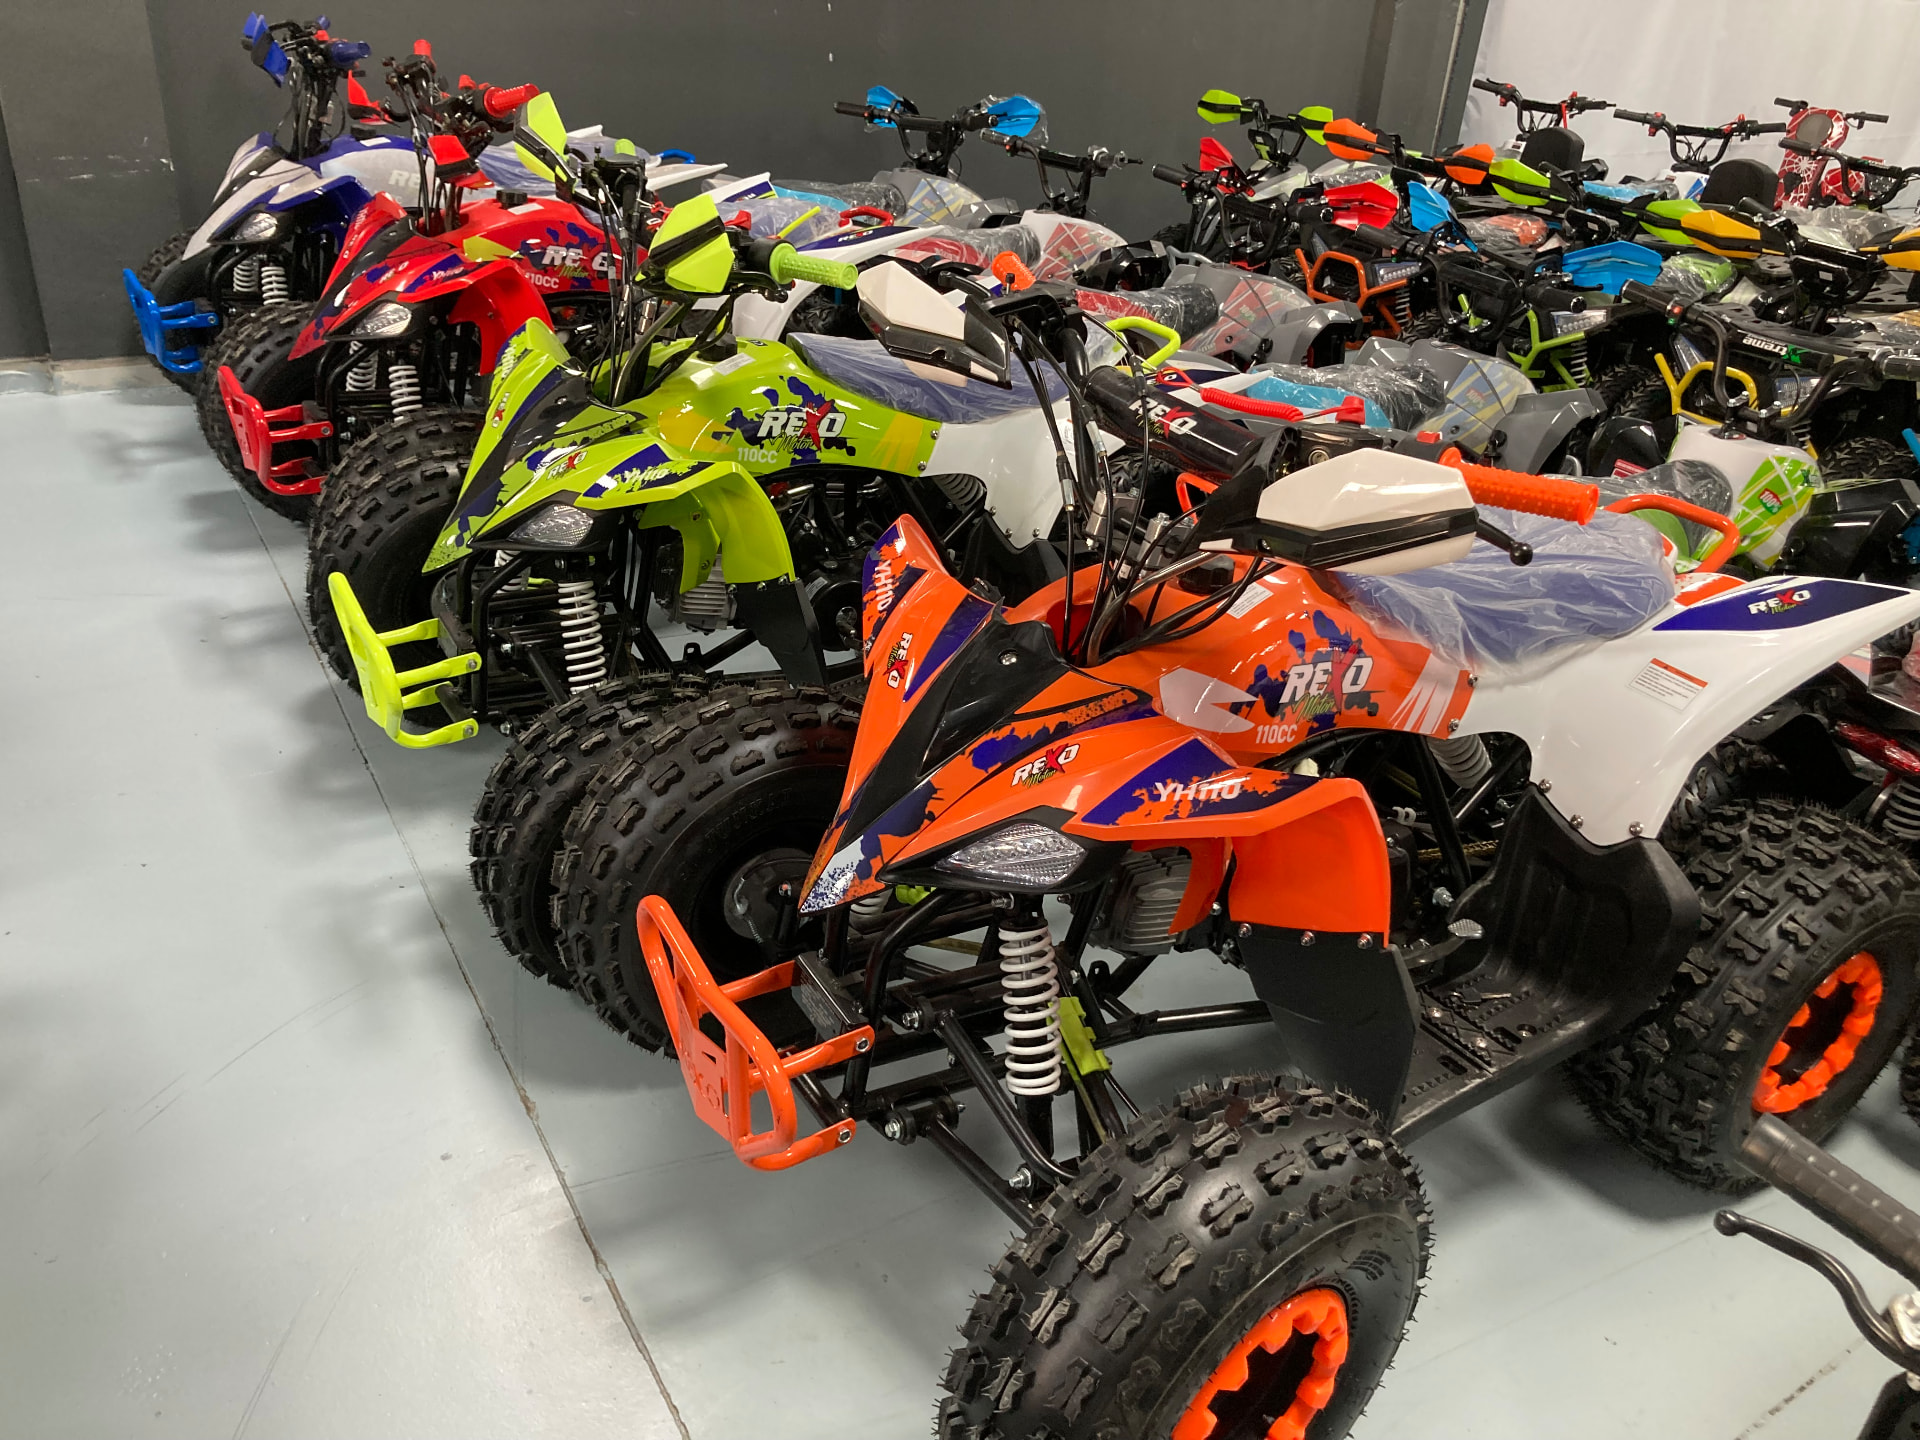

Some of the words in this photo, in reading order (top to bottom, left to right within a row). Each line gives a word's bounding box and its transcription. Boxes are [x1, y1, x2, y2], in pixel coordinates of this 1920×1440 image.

[757, 402, 847, 448] REXO
[768, 434, 814, 453] Motor
[738, 447, 778, 464] 110CC
[875, 559, 893, 612] YH110
[1747, 589, 1811, 615] REXO
[884, 631, 913, 689] REXO
[1279, 646, 1374, 708] REXO
[1293, 692, 1335, 724] Motor
[1256, 724, 1298, 744] 110CC
[1011, 743, 1080, 787] REXO
